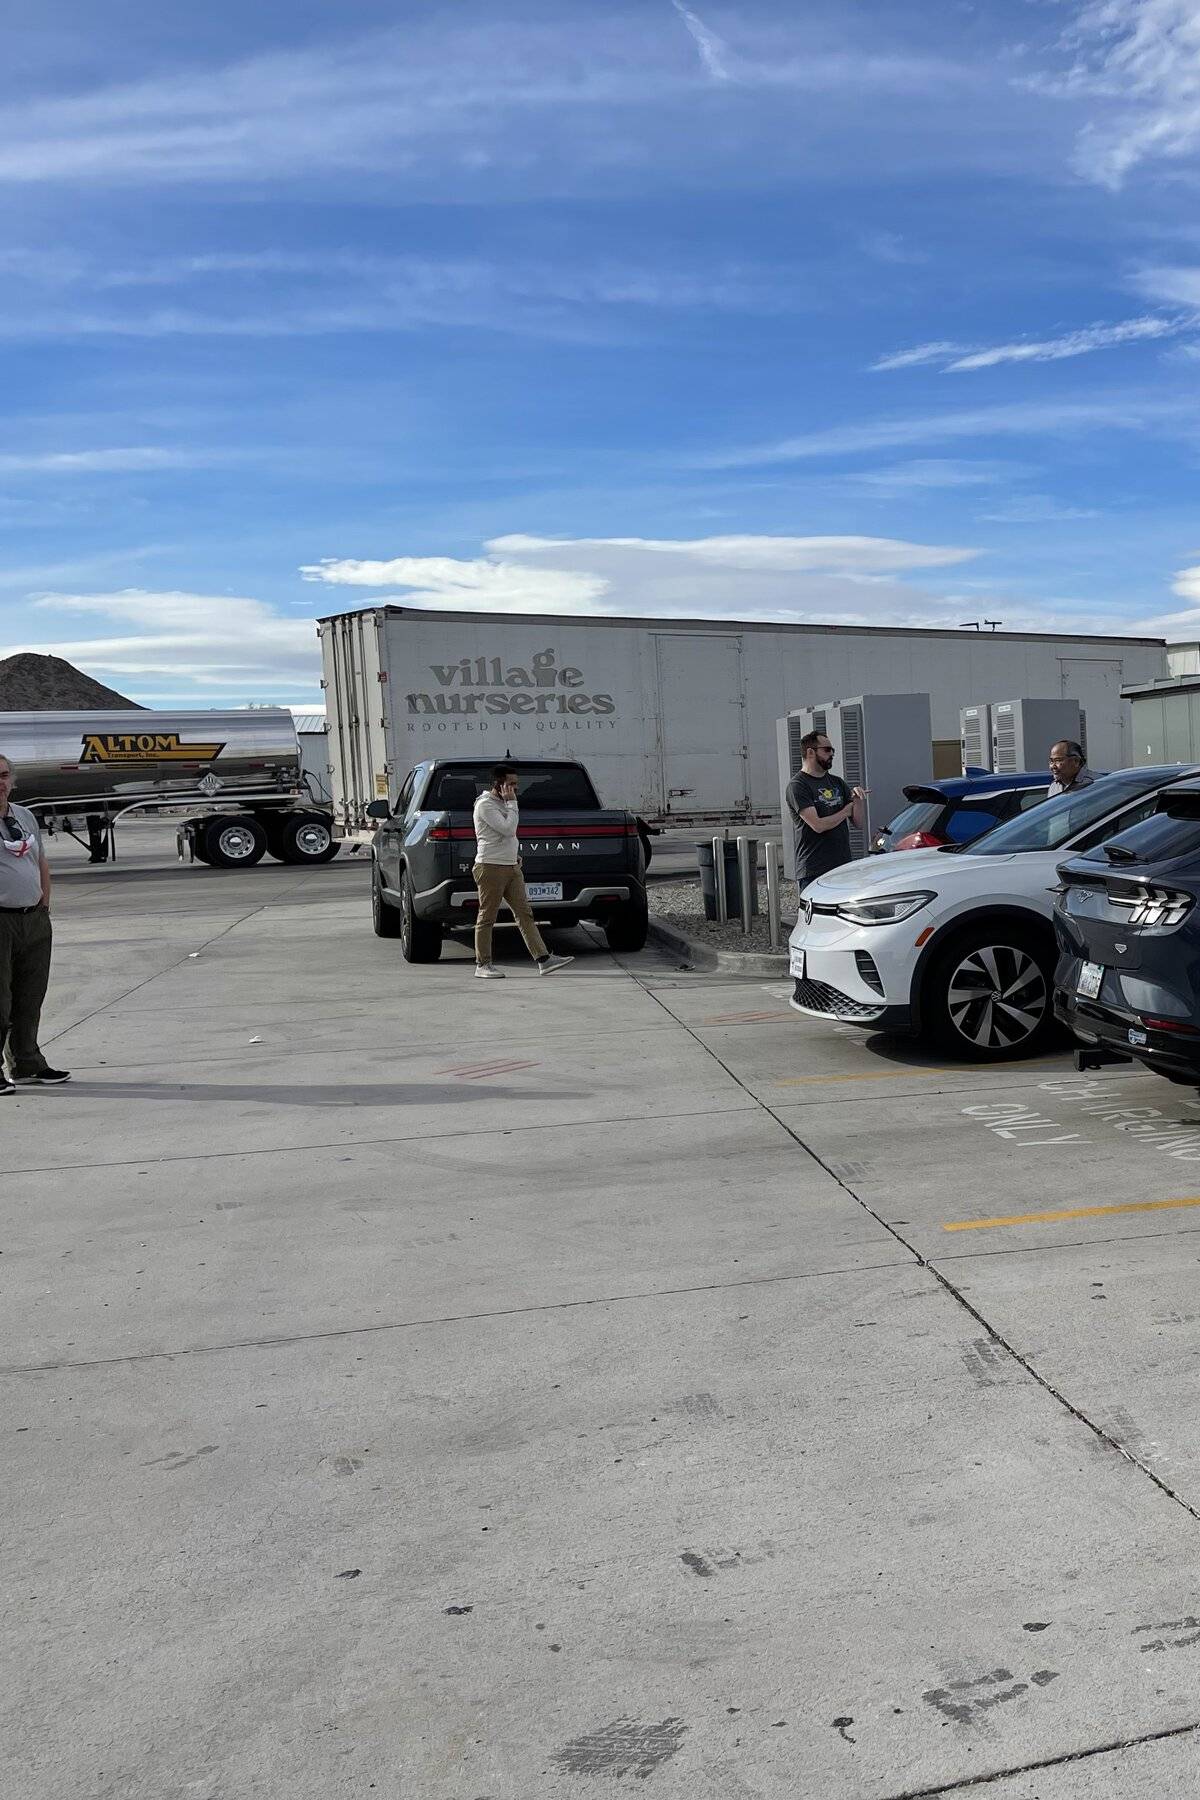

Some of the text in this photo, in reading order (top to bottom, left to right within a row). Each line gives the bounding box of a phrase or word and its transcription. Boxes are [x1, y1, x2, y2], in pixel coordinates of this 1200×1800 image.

[429, 647, 585, 688] village
[404, 692, 616, 716] nurseries
[406, 719, 618, 733] ROOTED IN QUALITY
[84, 735, 177, 761] ALTOM
[518, 842, 581, 851] IVIAN
[961, 1103, 1093, 1147] ONLY
